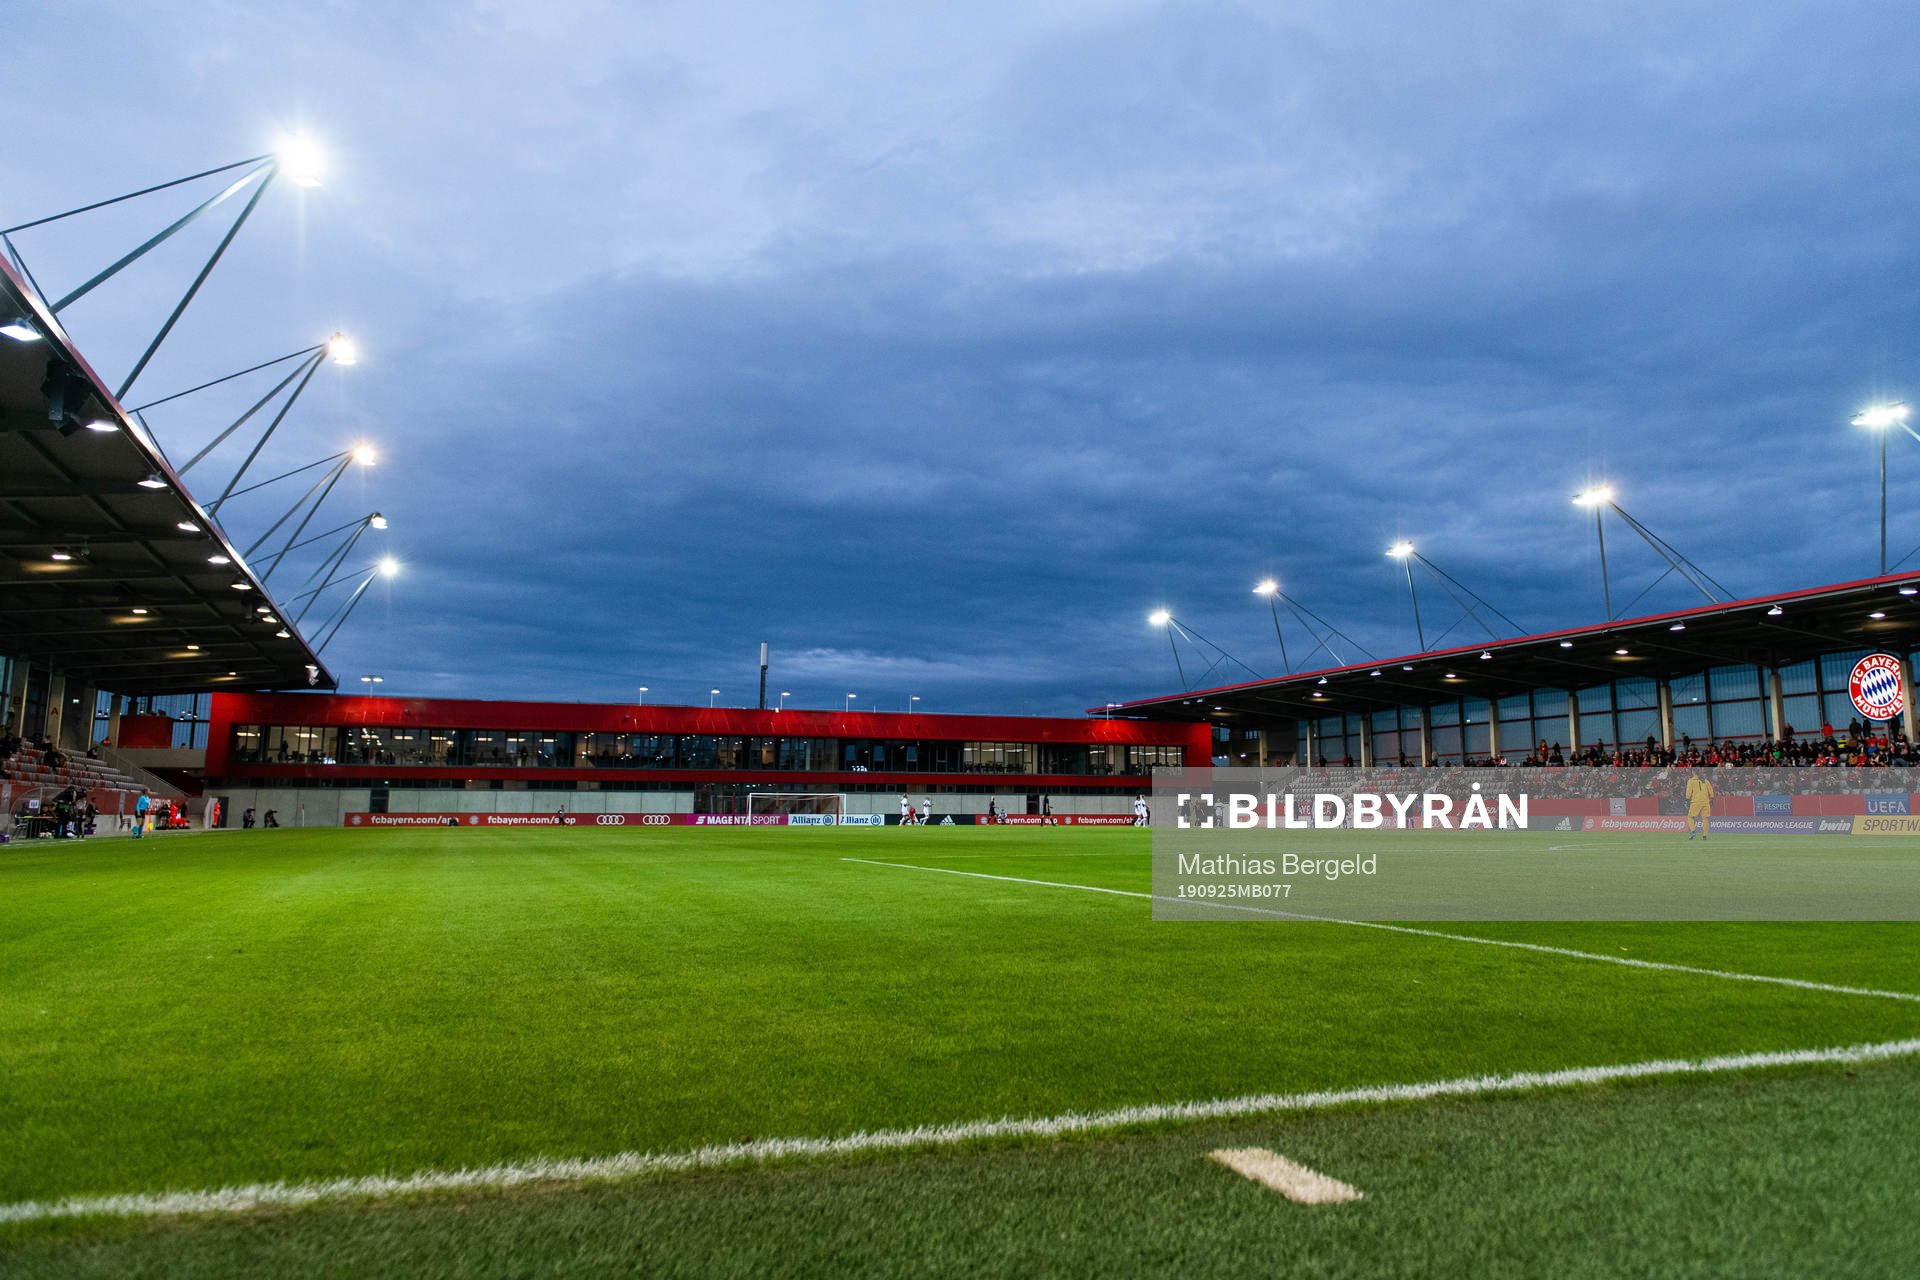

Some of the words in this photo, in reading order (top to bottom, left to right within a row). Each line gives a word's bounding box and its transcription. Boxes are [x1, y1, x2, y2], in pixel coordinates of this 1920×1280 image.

[1852, 669, 1864, 684] FC
[51, 707, 59, 716] A
[1868, 802, 1906, 814] UEFA
[488, 816, 576, 825] fcbayern.com/sop
[752, 816, 780, 825] SPORT
[792, 816, 820, 824] Allianz
[1601, 819, 1685, 830] fcbayern.com/shop
[1743, 821, 1784, 829] CHAMPIONS
[1785, 821, 1813, 829] LEAGUE
[1819, 819, 1851, 831] bwin
[1863, 819, 1920, 832] SPORTW
